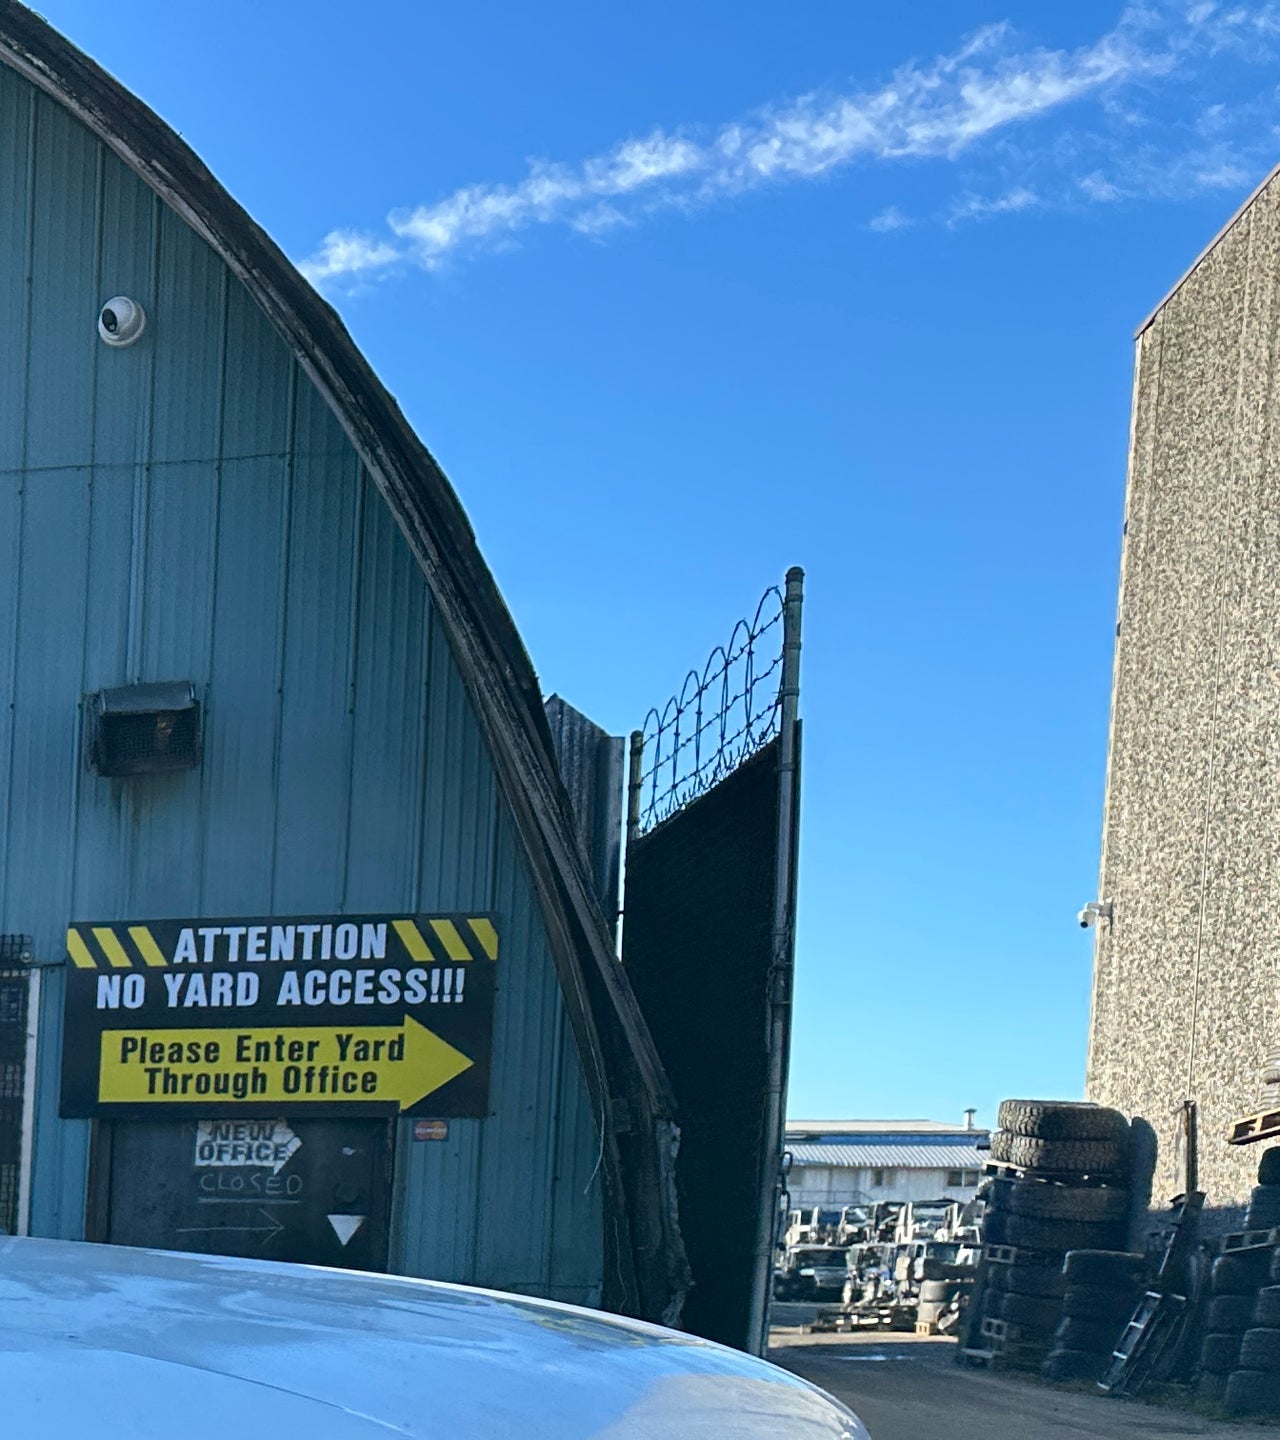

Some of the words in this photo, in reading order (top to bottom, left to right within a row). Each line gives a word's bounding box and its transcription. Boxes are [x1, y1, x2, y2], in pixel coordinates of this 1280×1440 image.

[173, 922, 388, 965] ATTENTION
[96, 974, 145, 1010] NO
[164, 972, 260, 1008] YARD
[276, 967, 466, 1005] ACCESS!!!
[120, 1036, 220, 1064] Please
[235, 1034, 321, 1063] Enter
[335, 1032, 405, 1062] Yard
[144, 1067, 268, 1099] Through
[282, 1065, 378, 1094] Office
[209, 1121, 276, 1142] NEW
[198, 1140, 290, 1162] OFFICE
[199, 1172, 303, 1195] CLOSED
